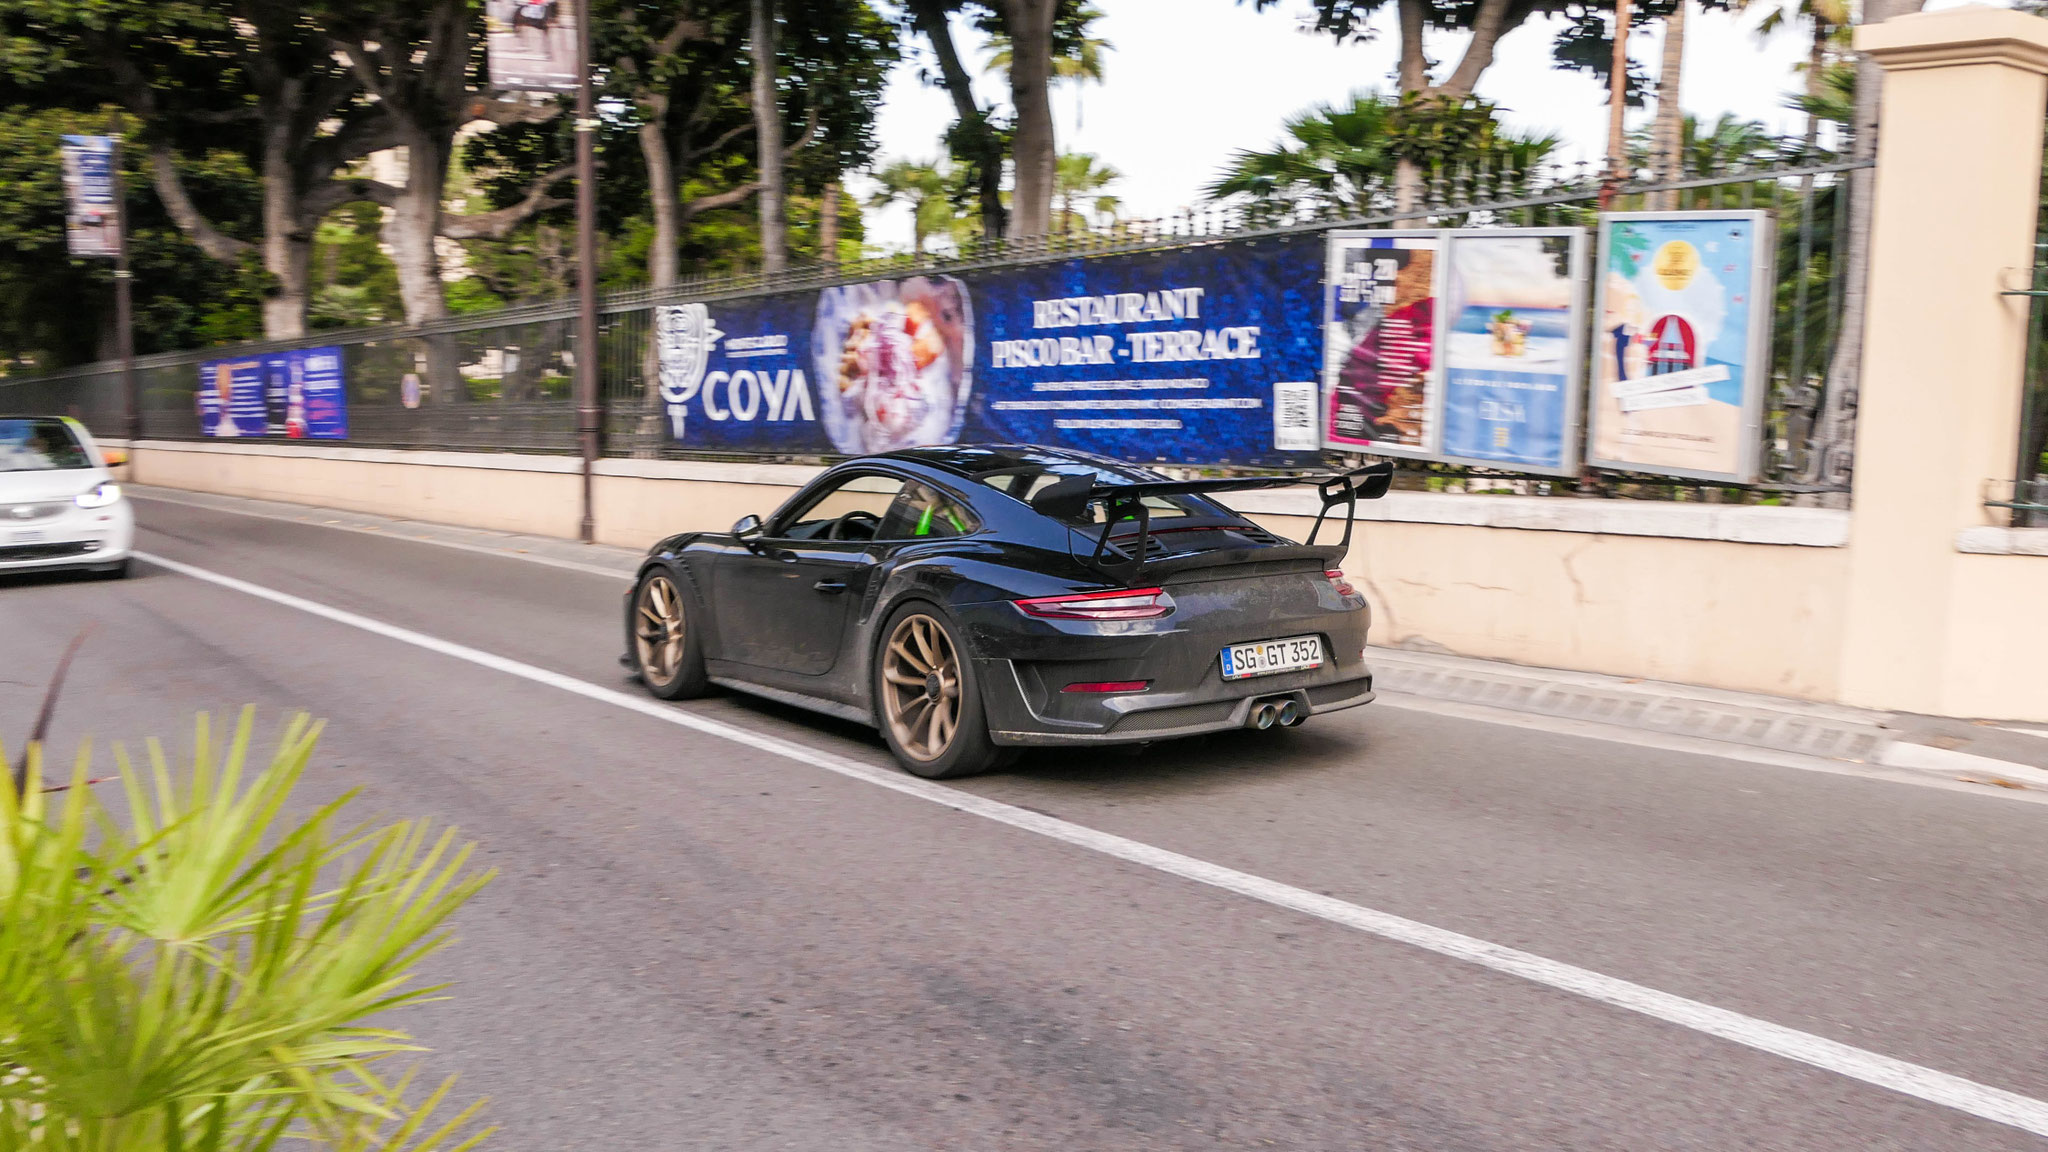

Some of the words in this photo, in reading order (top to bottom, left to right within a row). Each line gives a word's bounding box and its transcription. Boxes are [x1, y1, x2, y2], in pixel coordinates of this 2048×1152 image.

[1032, 287, 1205, 329] RESTAURANT
[701, 368, 816, 421] COYA
[1234, 648, 1257, 670] SG
[1266, 643, 1286, 666] GT
[1290, 639, 1319, 663] 352
